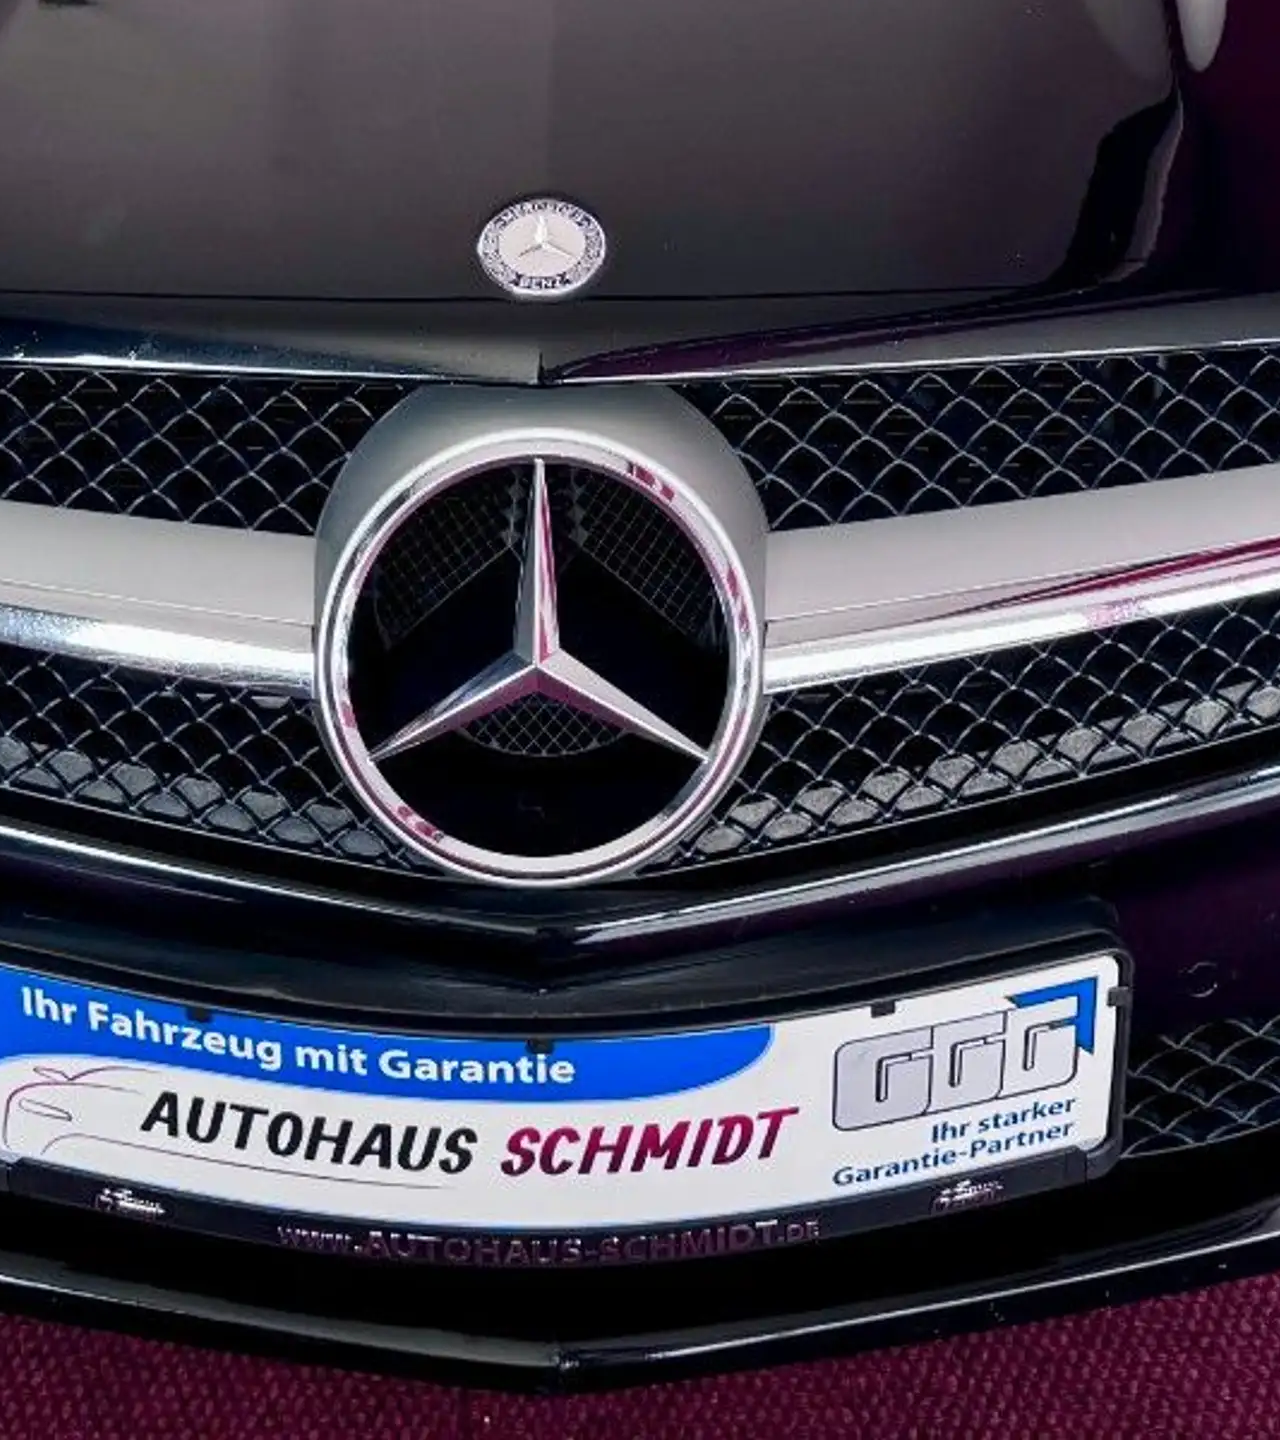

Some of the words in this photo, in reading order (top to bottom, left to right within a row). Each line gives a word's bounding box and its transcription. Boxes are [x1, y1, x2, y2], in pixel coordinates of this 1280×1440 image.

[21, 986, 77, 1025] Ihr
[87, 1001, 282, 1069] Fahrzeug
[295, 1044, 368, 1076] mit
[378, 1050, 576, 1084] Garantie
[140, 1091, 479, 1175] AUTOHAUS
[500, 1107, 800, 1177] SCHMIDT
[832, 1121, 1075, 1188] Garantie-Partner
[931, 1121, 971, 1144] Ihr
[978, 1097, 1077, 1134] starker
